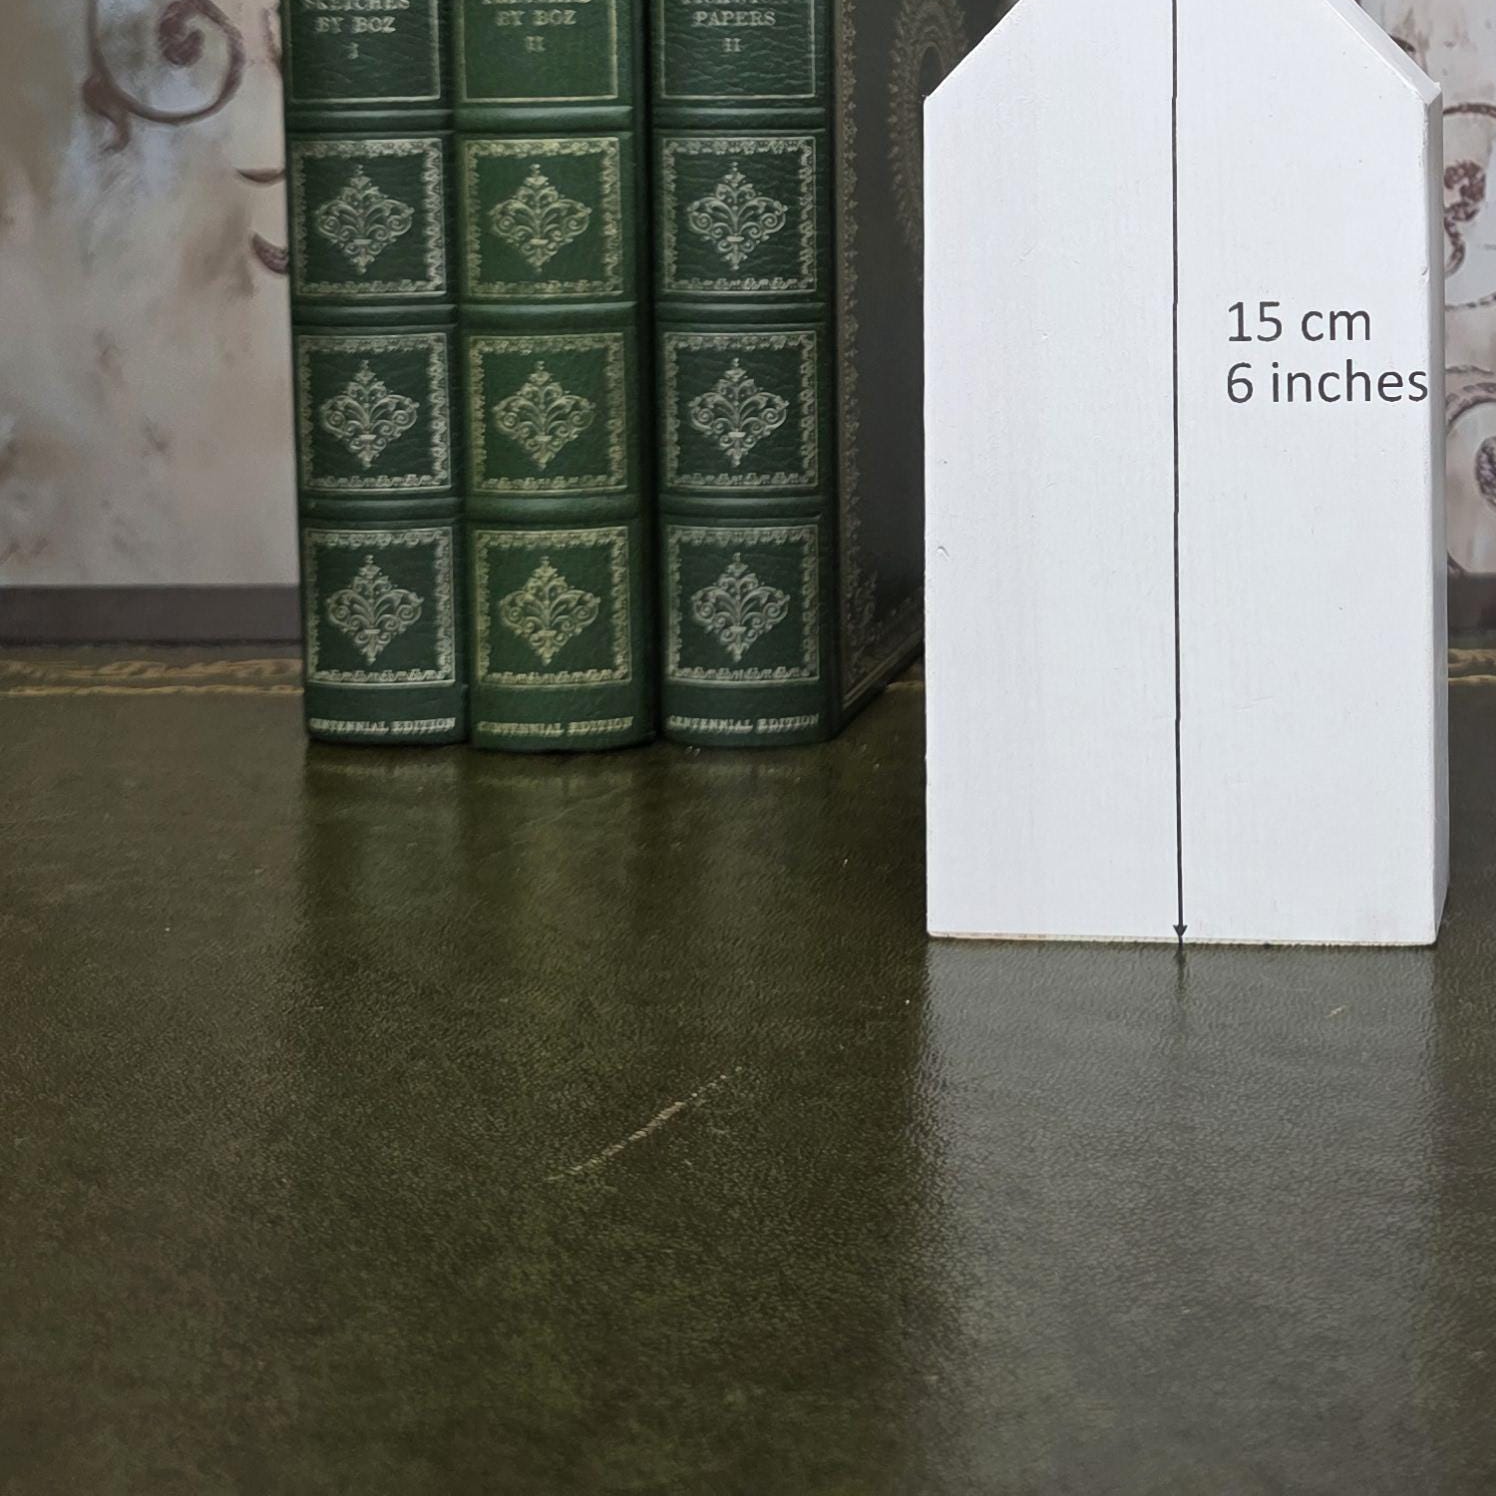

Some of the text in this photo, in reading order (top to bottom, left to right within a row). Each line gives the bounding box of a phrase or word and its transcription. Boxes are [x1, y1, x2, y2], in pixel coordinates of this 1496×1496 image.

[352, 16, 396, 33] BOZ
[533, 8, 576, 25] BOZ
[693, 9, 776, 26] PAPERS
[1229, 301, 1370, 341] 15 cm
[1228, 359, 1428, 403] 6 inches
[391, 718, 456, 734] EDITION
[757, 713, 819, 734] EDITION
